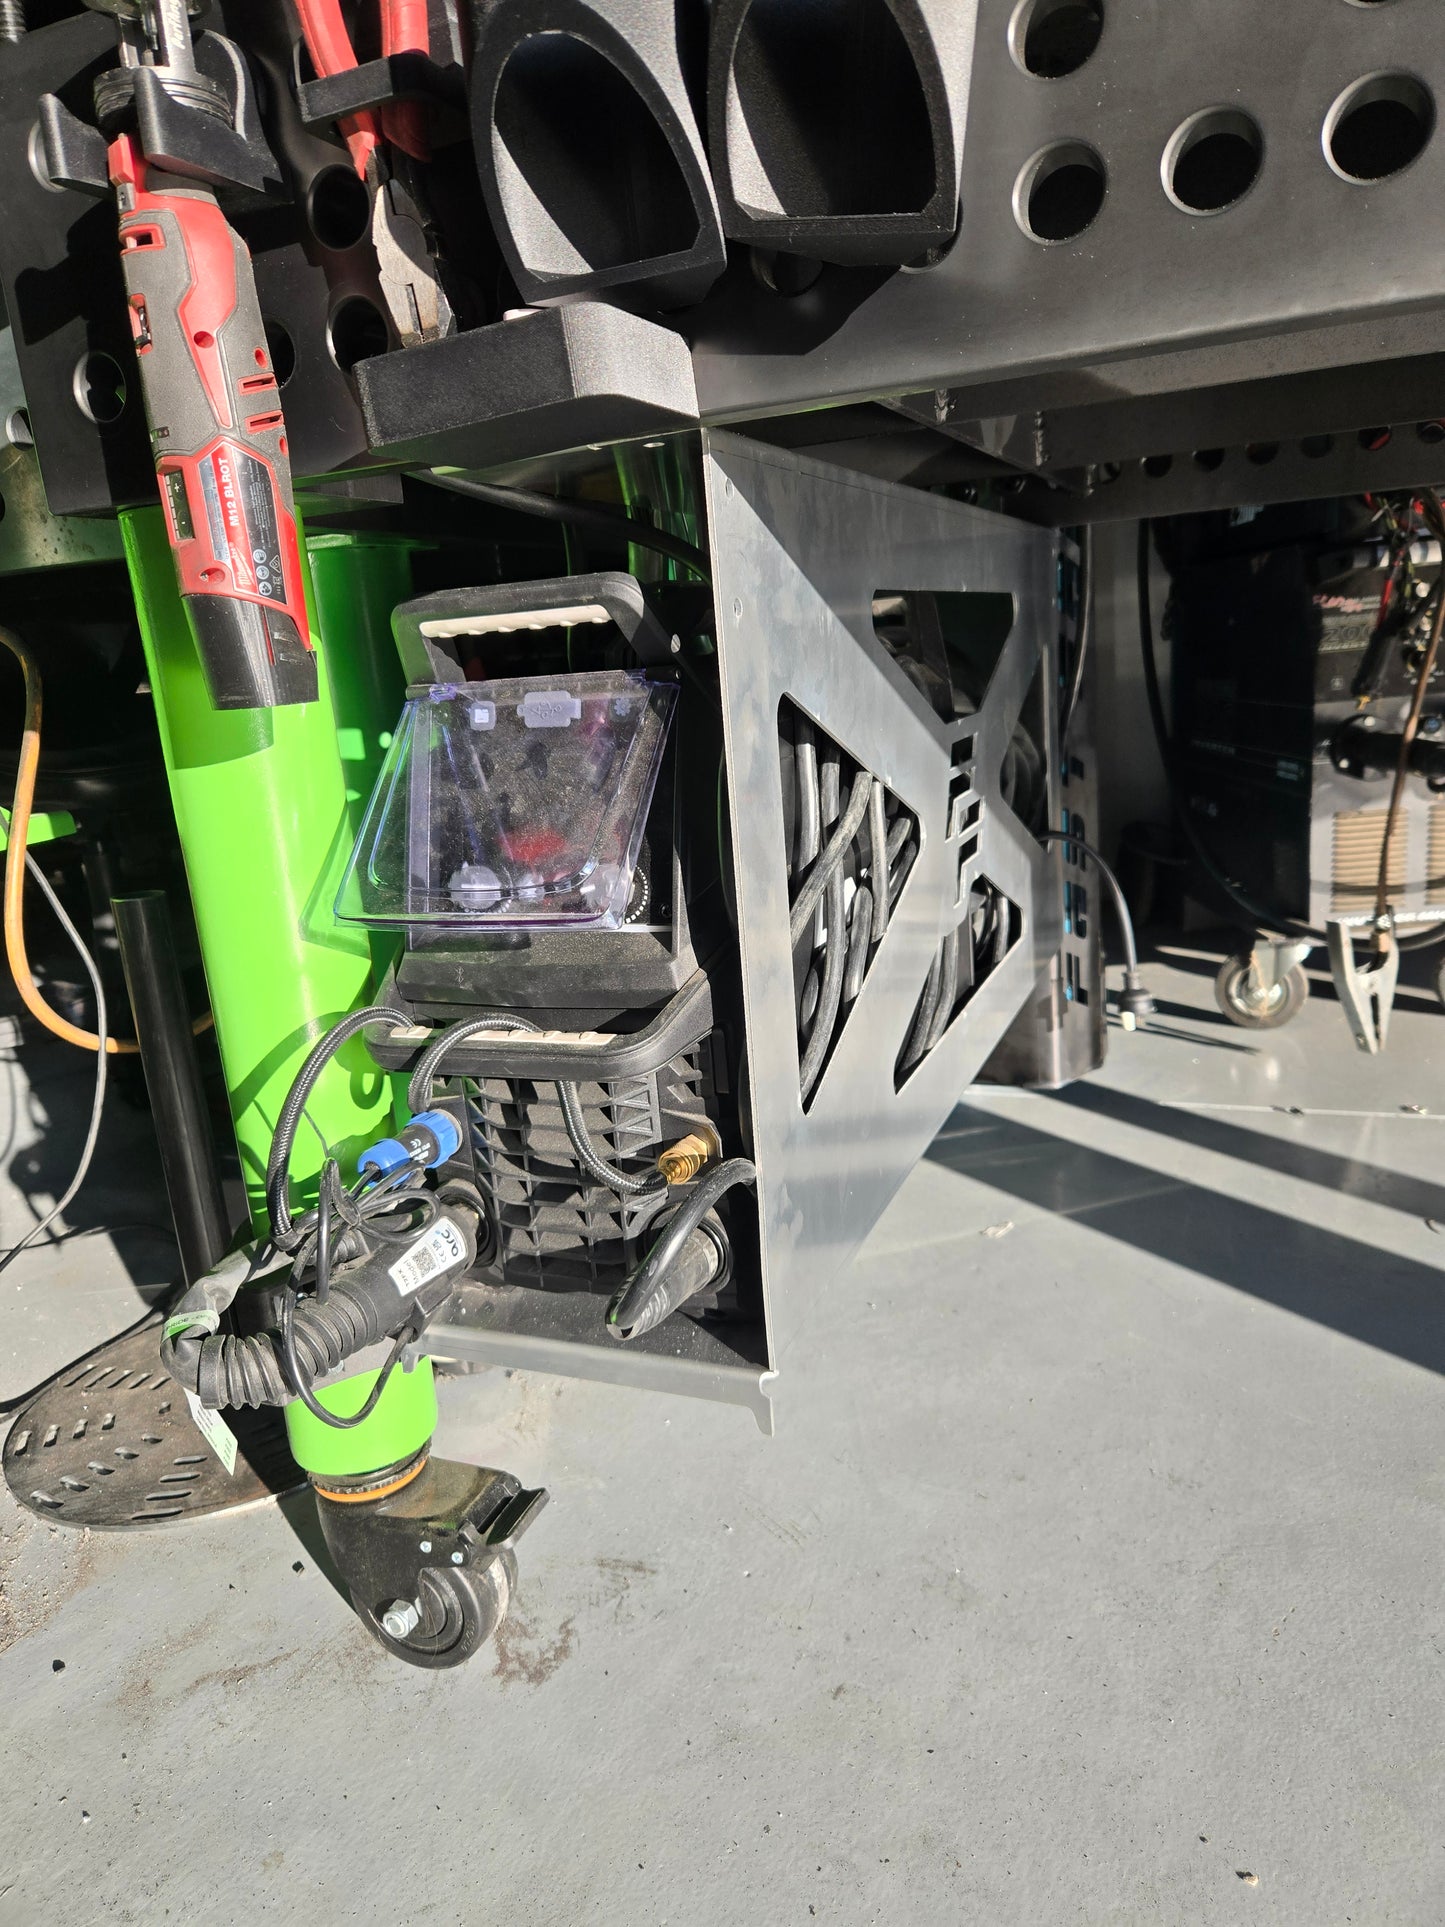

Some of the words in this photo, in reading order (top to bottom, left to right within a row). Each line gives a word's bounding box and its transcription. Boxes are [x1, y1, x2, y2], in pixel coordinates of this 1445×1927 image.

[218, 457, 235, 498] BLROT
[227, 500, 240, 527] M12
[441, 1229, 459, 1257] arc
[403, 1259, 419, 1285] Model
